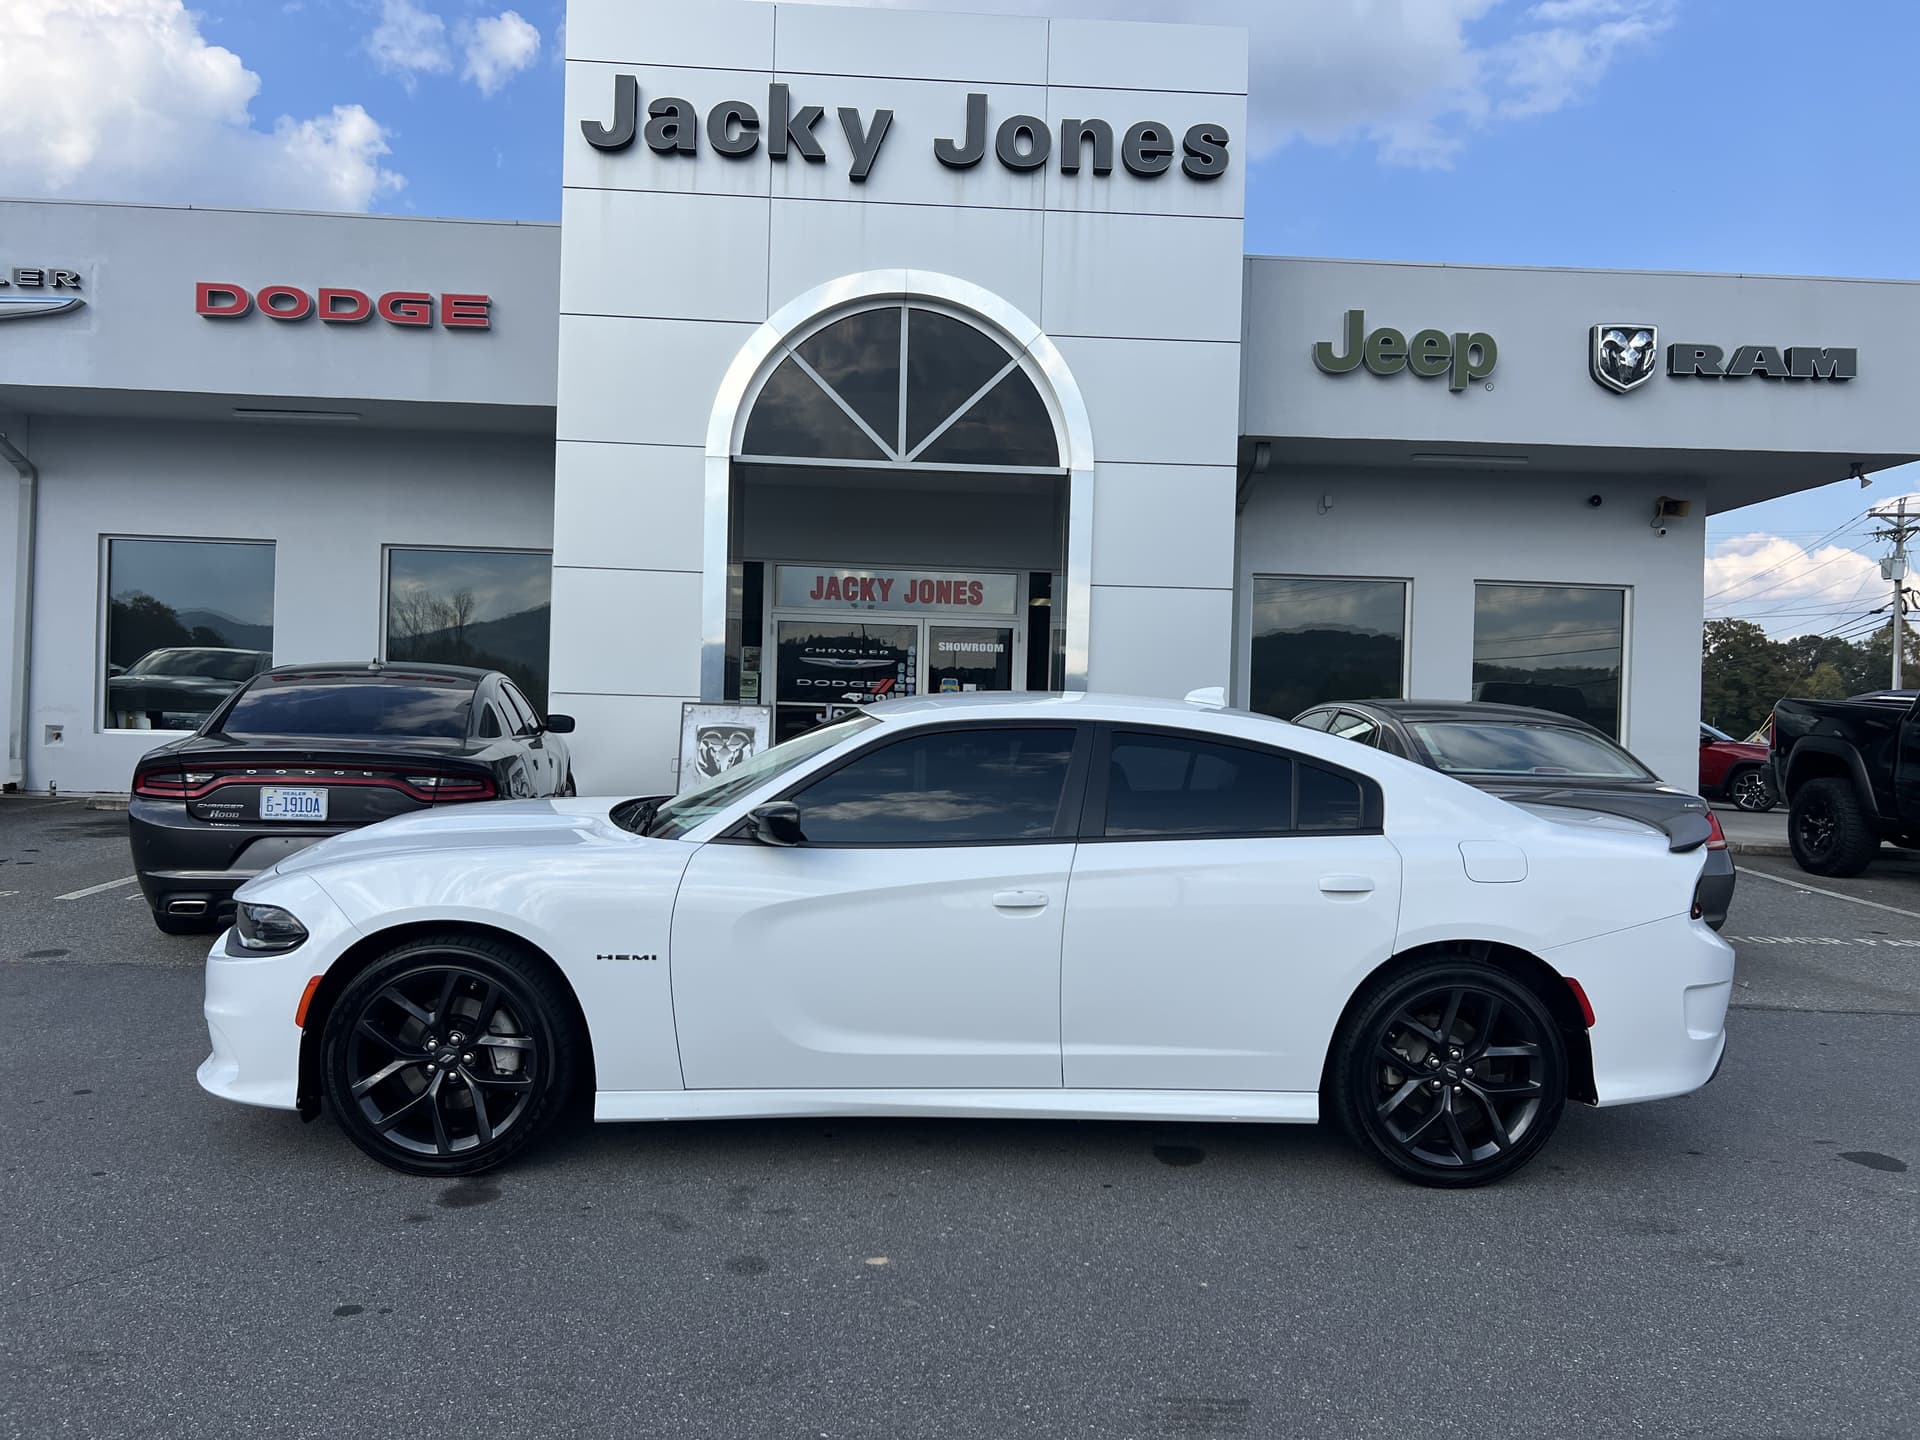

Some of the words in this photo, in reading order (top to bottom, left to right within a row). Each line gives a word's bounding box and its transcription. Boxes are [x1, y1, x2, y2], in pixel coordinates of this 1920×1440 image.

[580, 74, 895, 183] Jacky
[933, 92, 1230, 182] Jones
[195, 281, 492, 330] DODGE
[1311, 308, 1498, 392] Jeep
[1667, 342, 1858, 380] RAM
[809, 575, 895, 602] JACKY
[903, 578, 984, 606] JONES
[804, 647, 889, 656] CHRYSLER
[937, 641, 1005, 653] SHOWROOM
[796, 678, 882, 689] DODGE
[246, 769, 373, 777] DODGE
